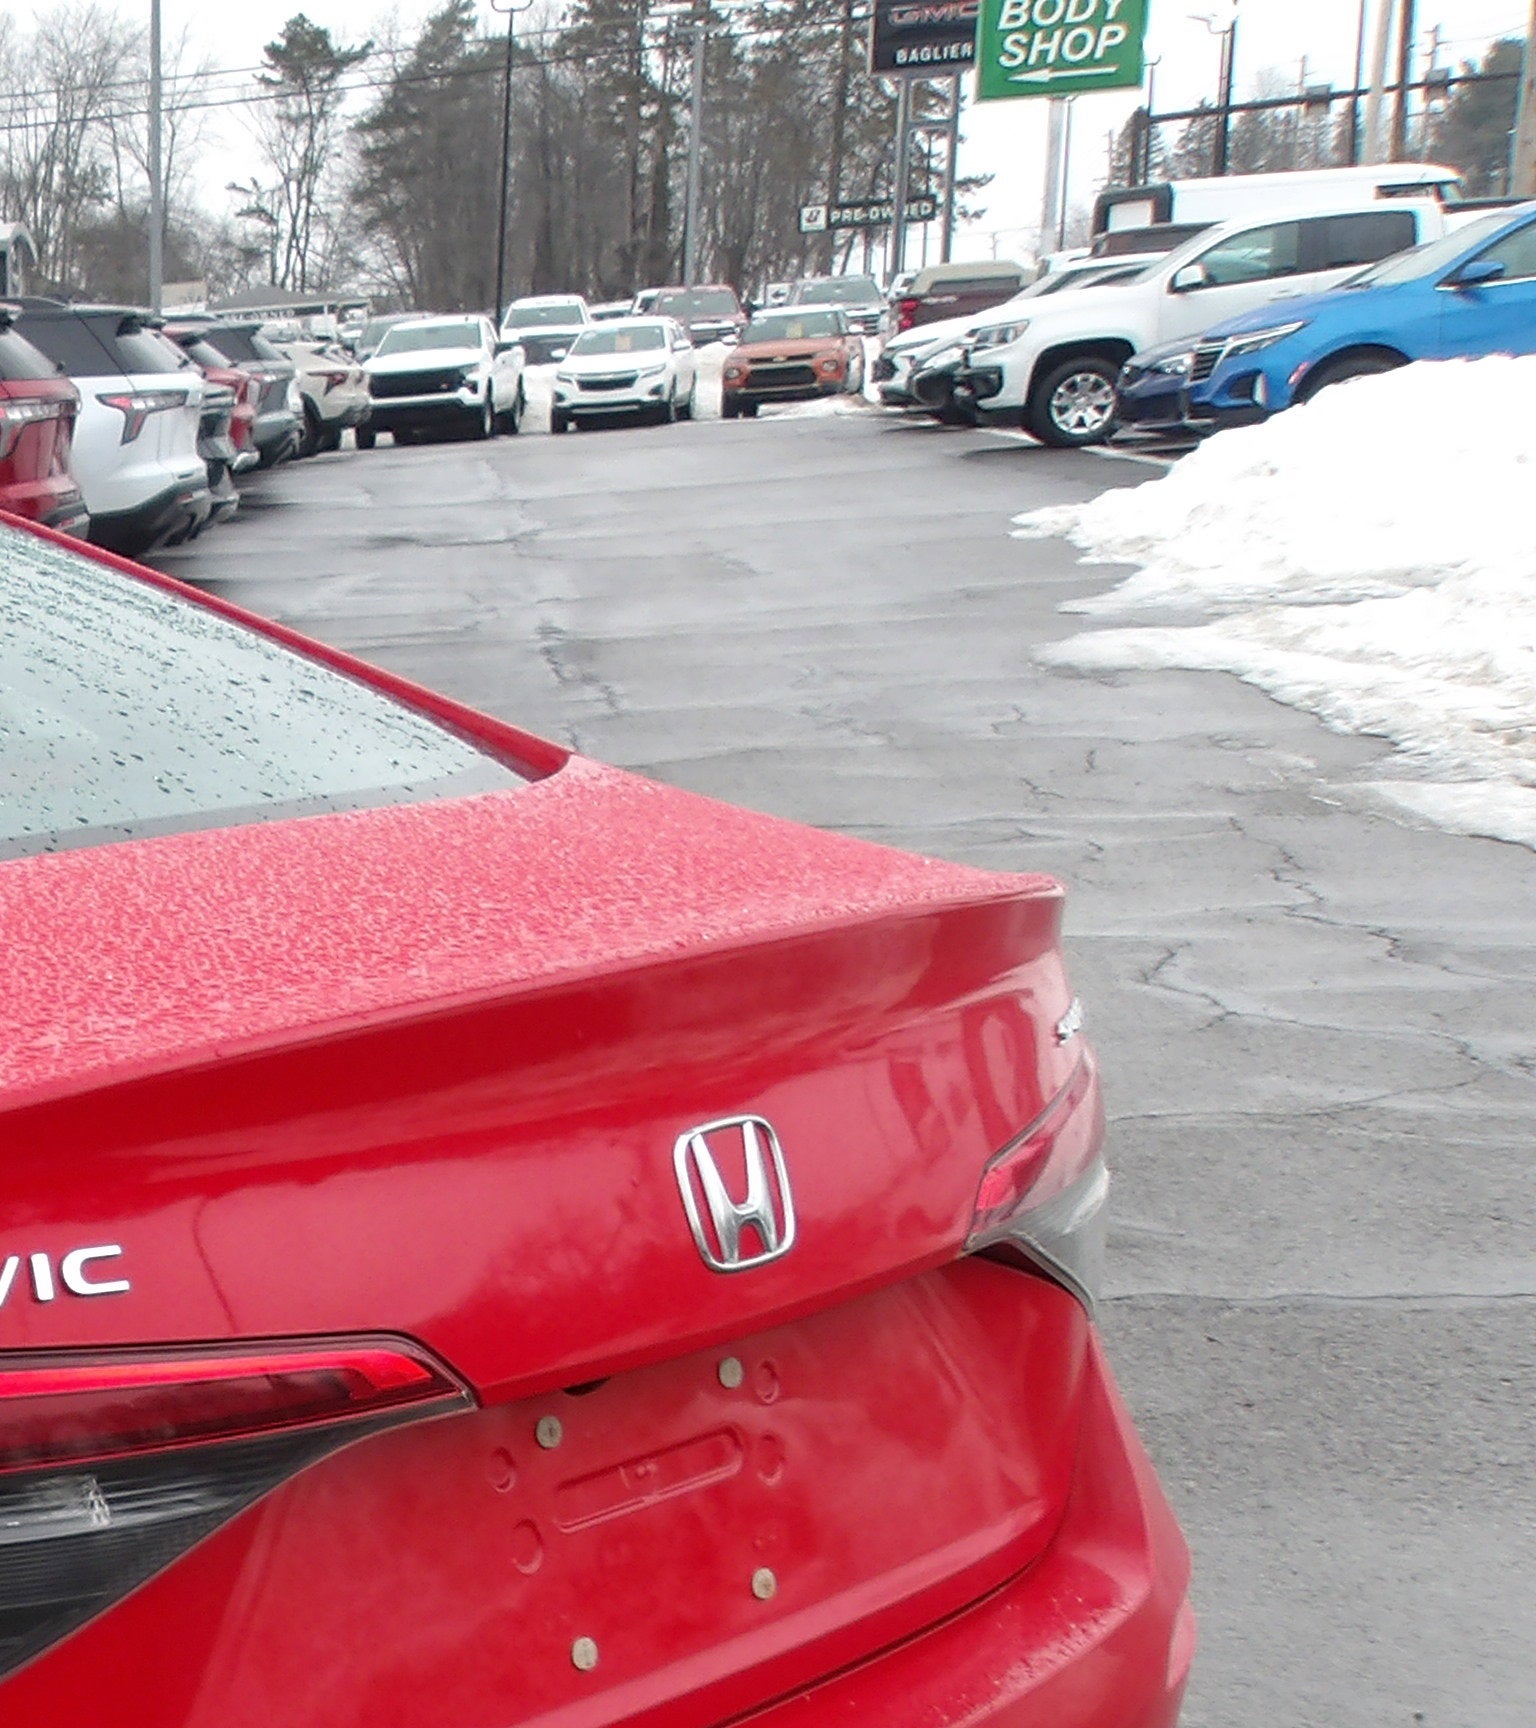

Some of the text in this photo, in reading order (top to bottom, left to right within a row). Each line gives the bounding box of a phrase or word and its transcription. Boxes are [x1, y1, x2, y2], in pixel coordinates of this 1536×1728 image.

[998, 0, 1125, 30] BODY
[895, 41, 974, 65] BAGLIER
[998, 23, 1127, 67] SHOP
